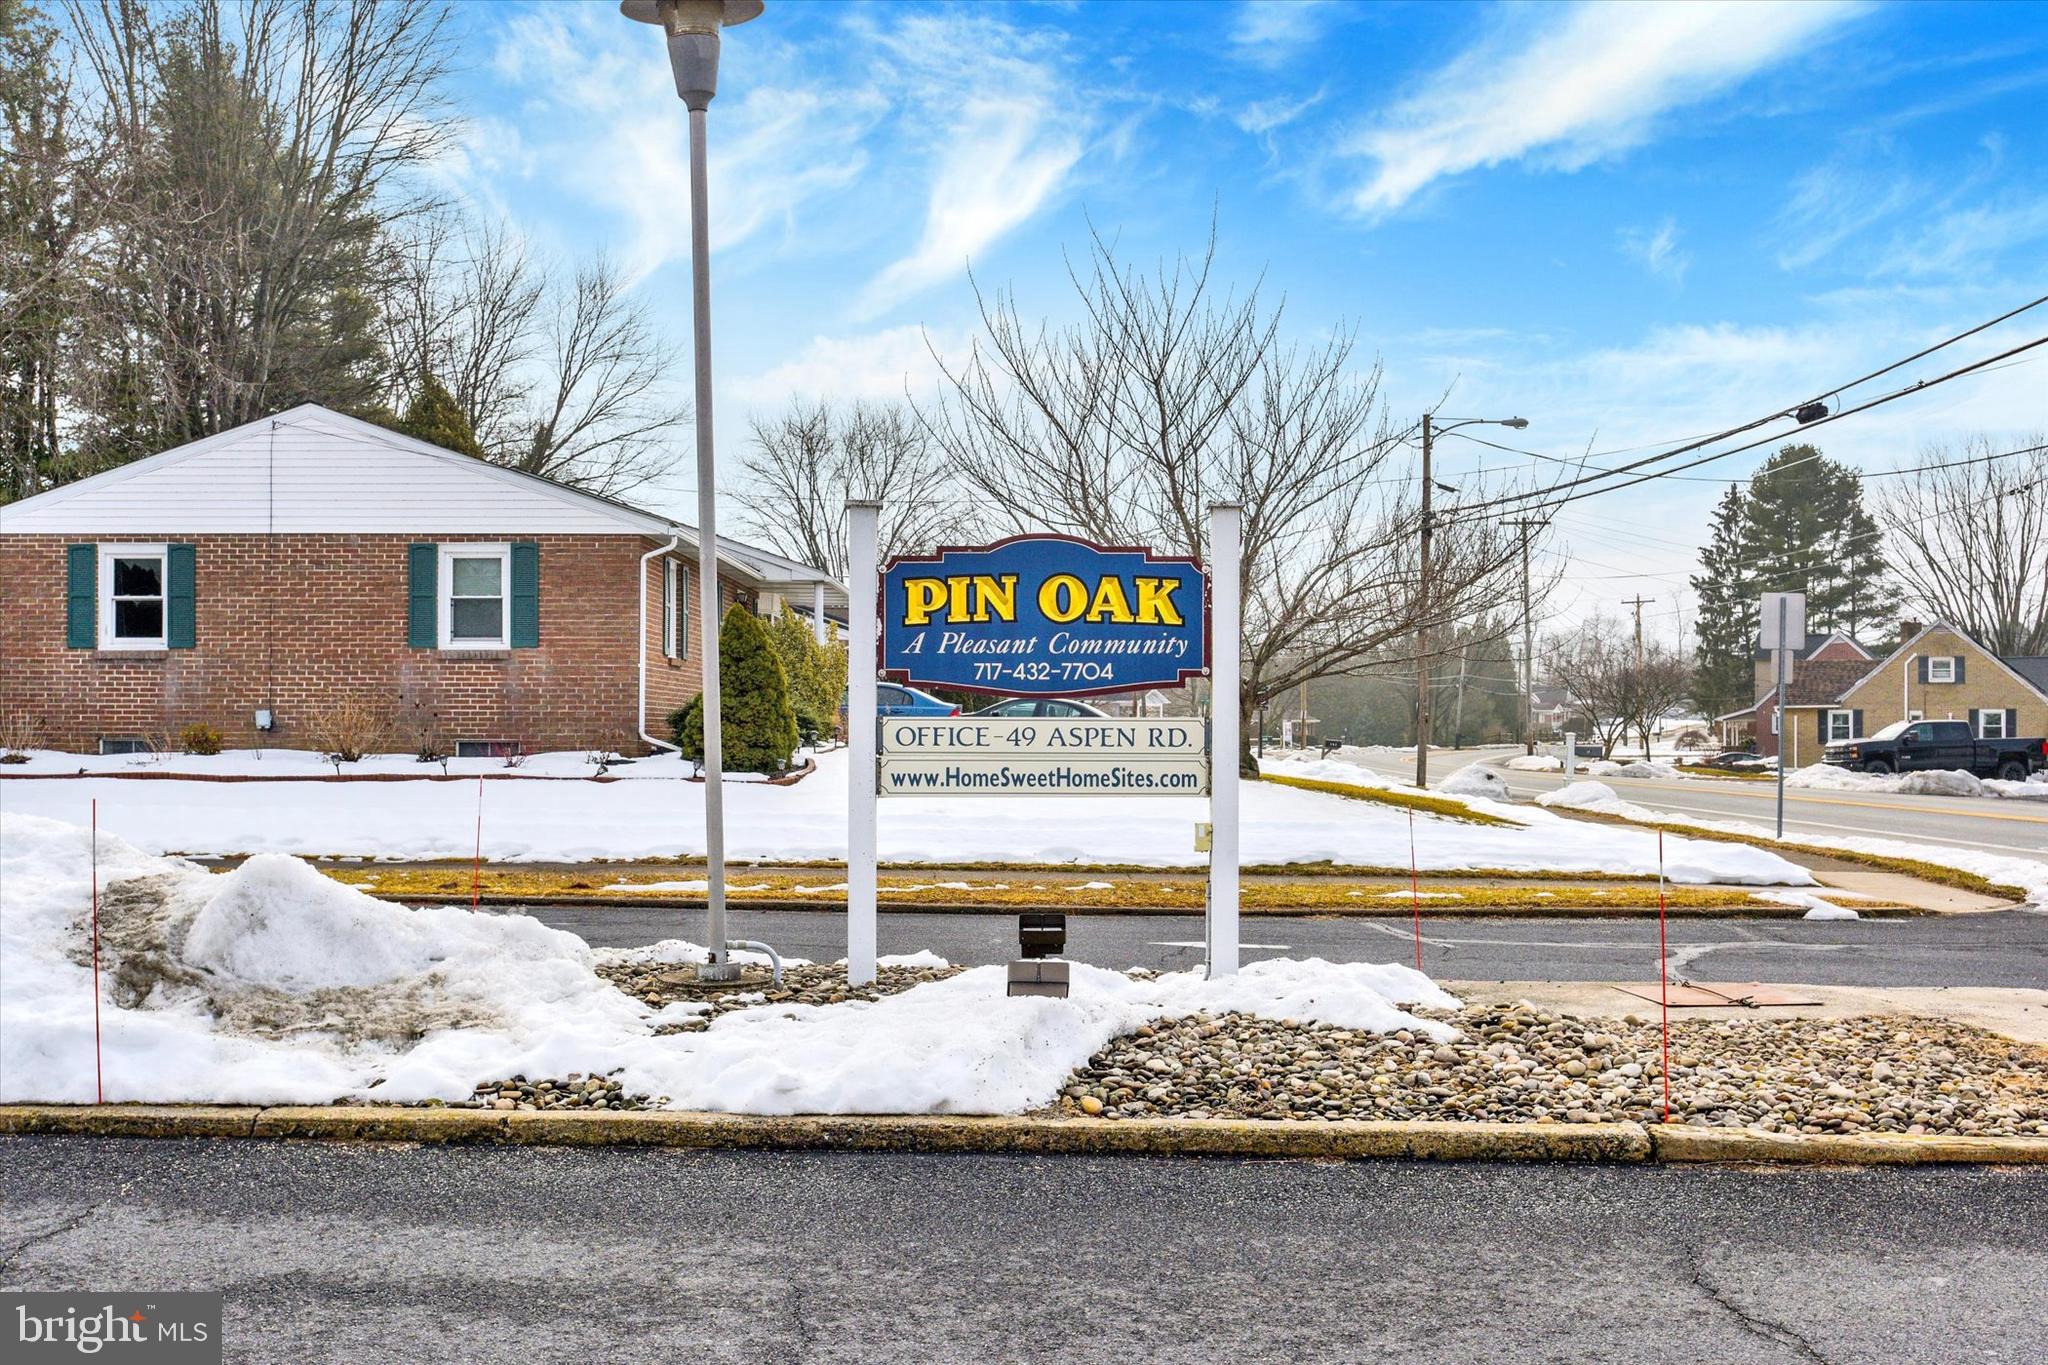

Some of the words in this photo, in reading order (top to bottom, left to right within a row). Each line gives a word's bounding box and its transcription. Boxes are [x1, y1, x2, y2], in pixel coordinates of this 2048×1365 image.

[902, 572, 1019, 627] PIN
[1037, 573, 1185, 627] OAK
[902, 632, 923, 654] A
[937, 632, 1038, 654] Pleasant
[1048, 631, 1189, 657] Community
[973, 662, 1115, 681] 717-432-7704
[1046, 727, 1137, 747] ASPEN
[1148, 727, 1193, 748] RD.
[890, 767, 1199, 788] www.HomeSweetHomeSites.com
